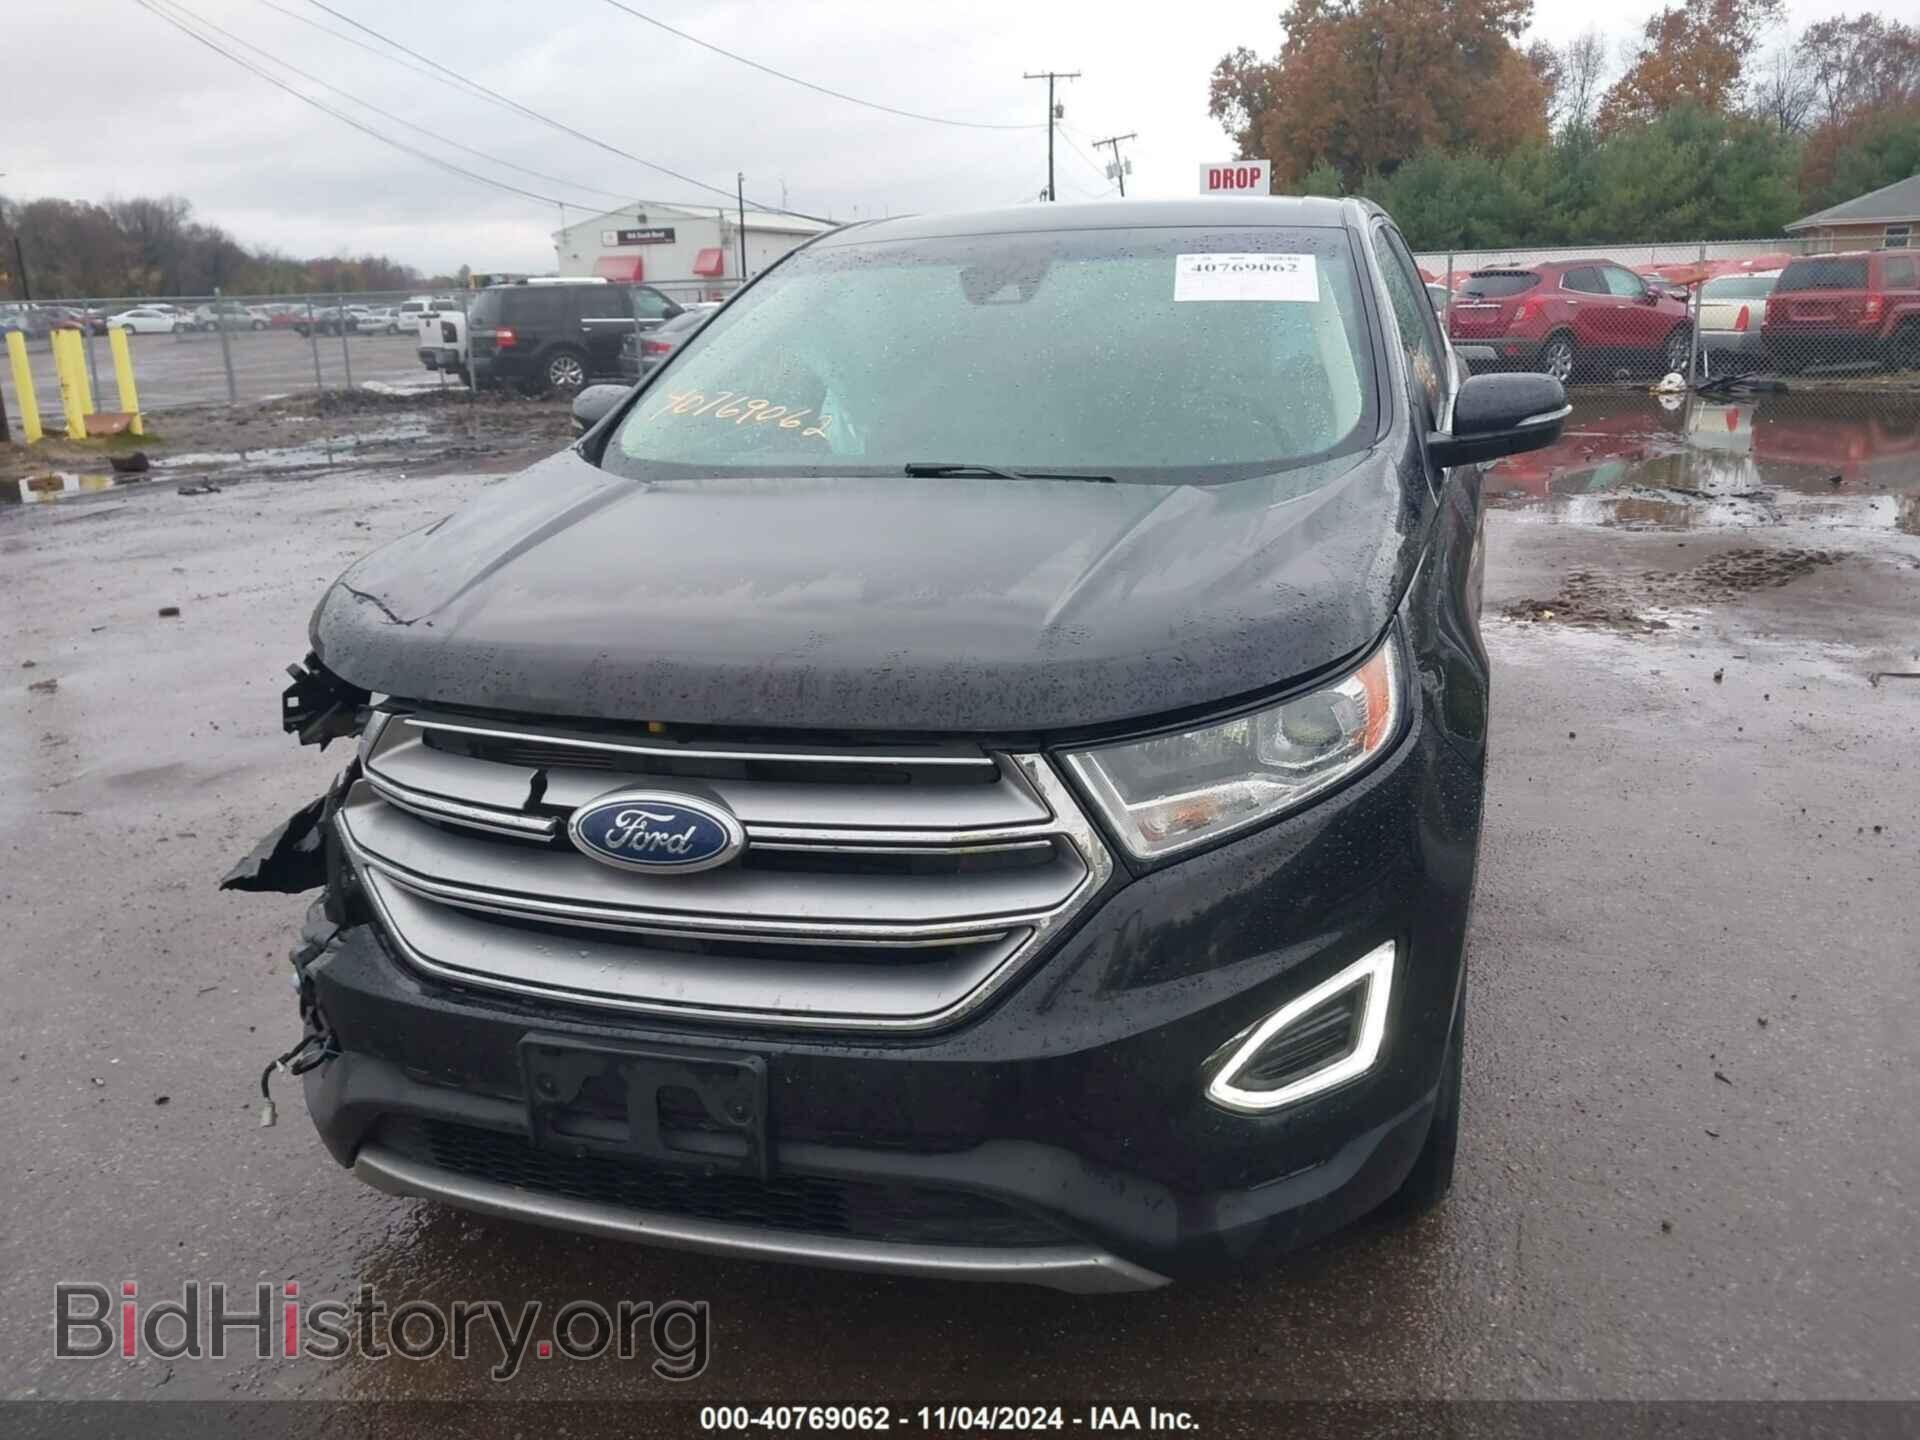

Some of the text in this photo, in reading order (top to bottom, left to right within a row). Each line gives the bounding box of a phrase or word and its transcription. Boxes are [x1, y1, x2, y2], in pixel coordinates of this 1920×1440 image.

[1208, 167, 1262, 190] DROP
[1191, 263, 1299, 273] 40769062
[650, 389, 833, 439] 40769062
[604, 809, 697, 854] Ford
